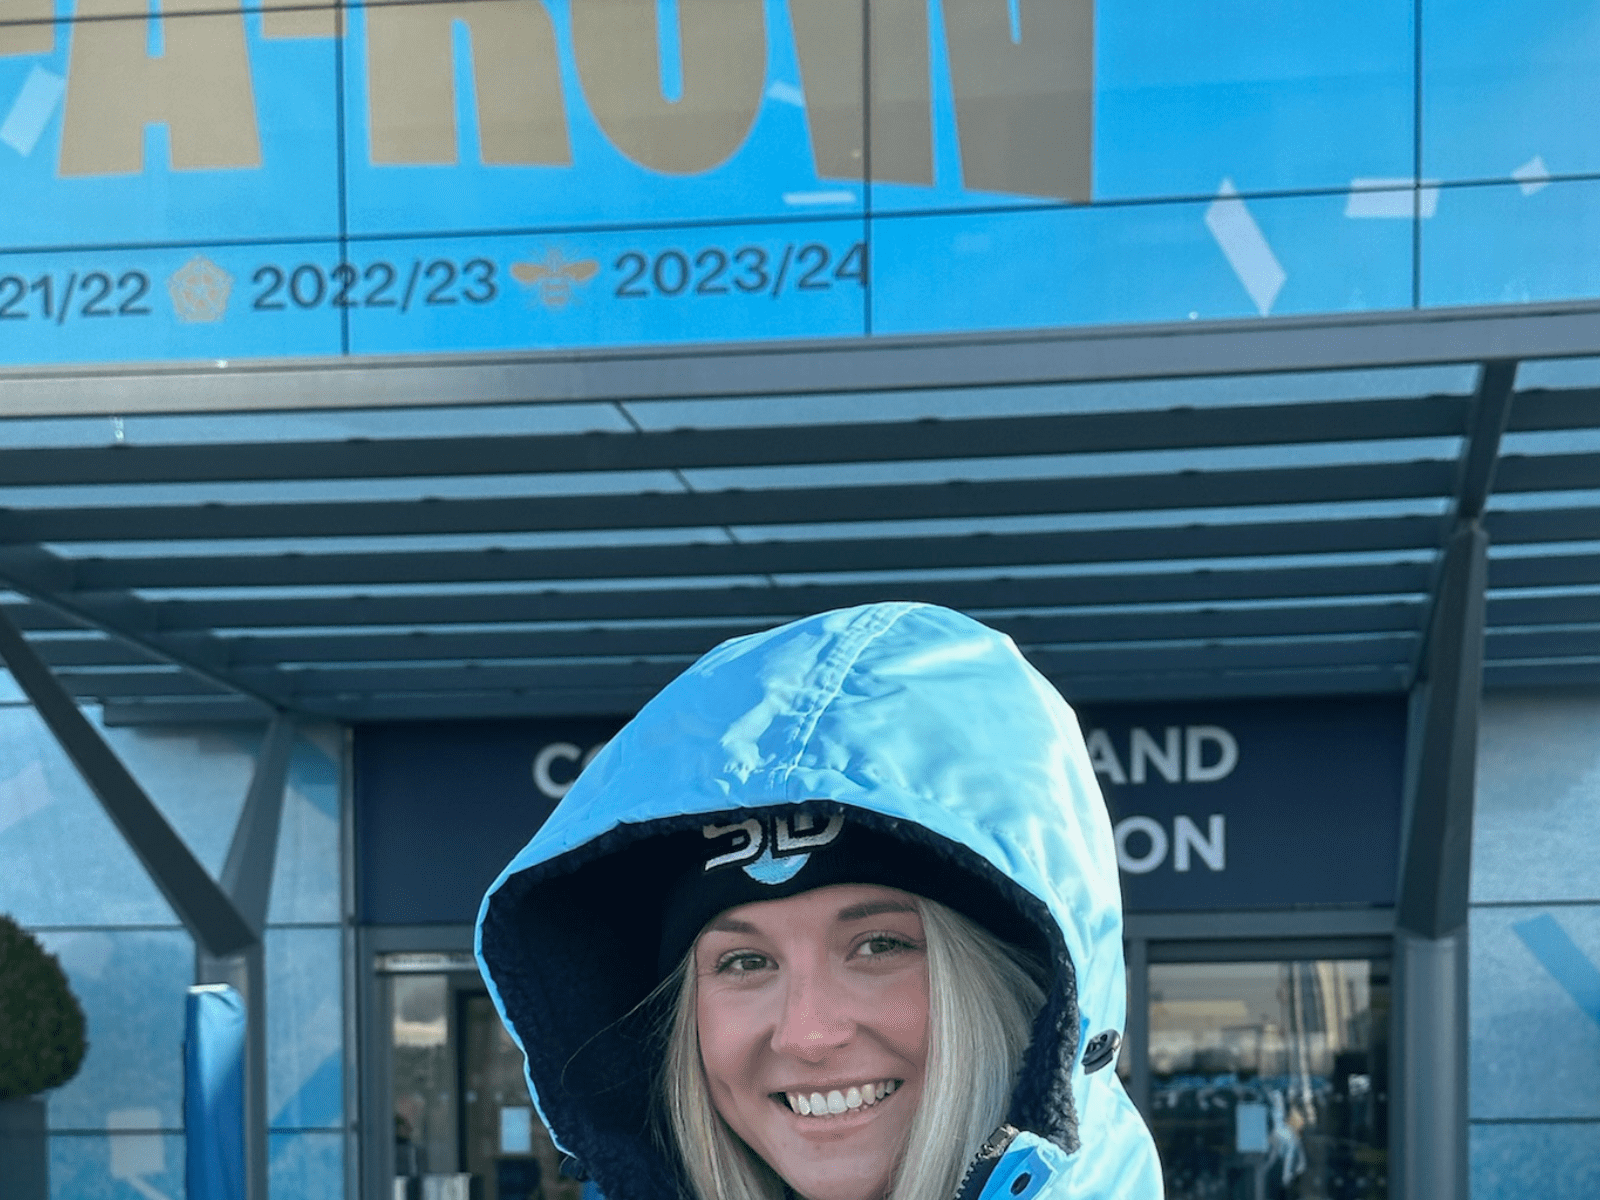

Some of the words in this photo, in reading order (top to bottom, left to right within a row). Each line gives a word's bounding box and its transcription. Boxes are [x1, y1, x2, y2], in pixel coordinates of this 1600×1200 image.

[252, 258, 499, 315] 2022/23
[614, 240, 869, 300] 2023/24
[533, 741, 606, 799] C
[1087, 725, 1240, 784] AND
